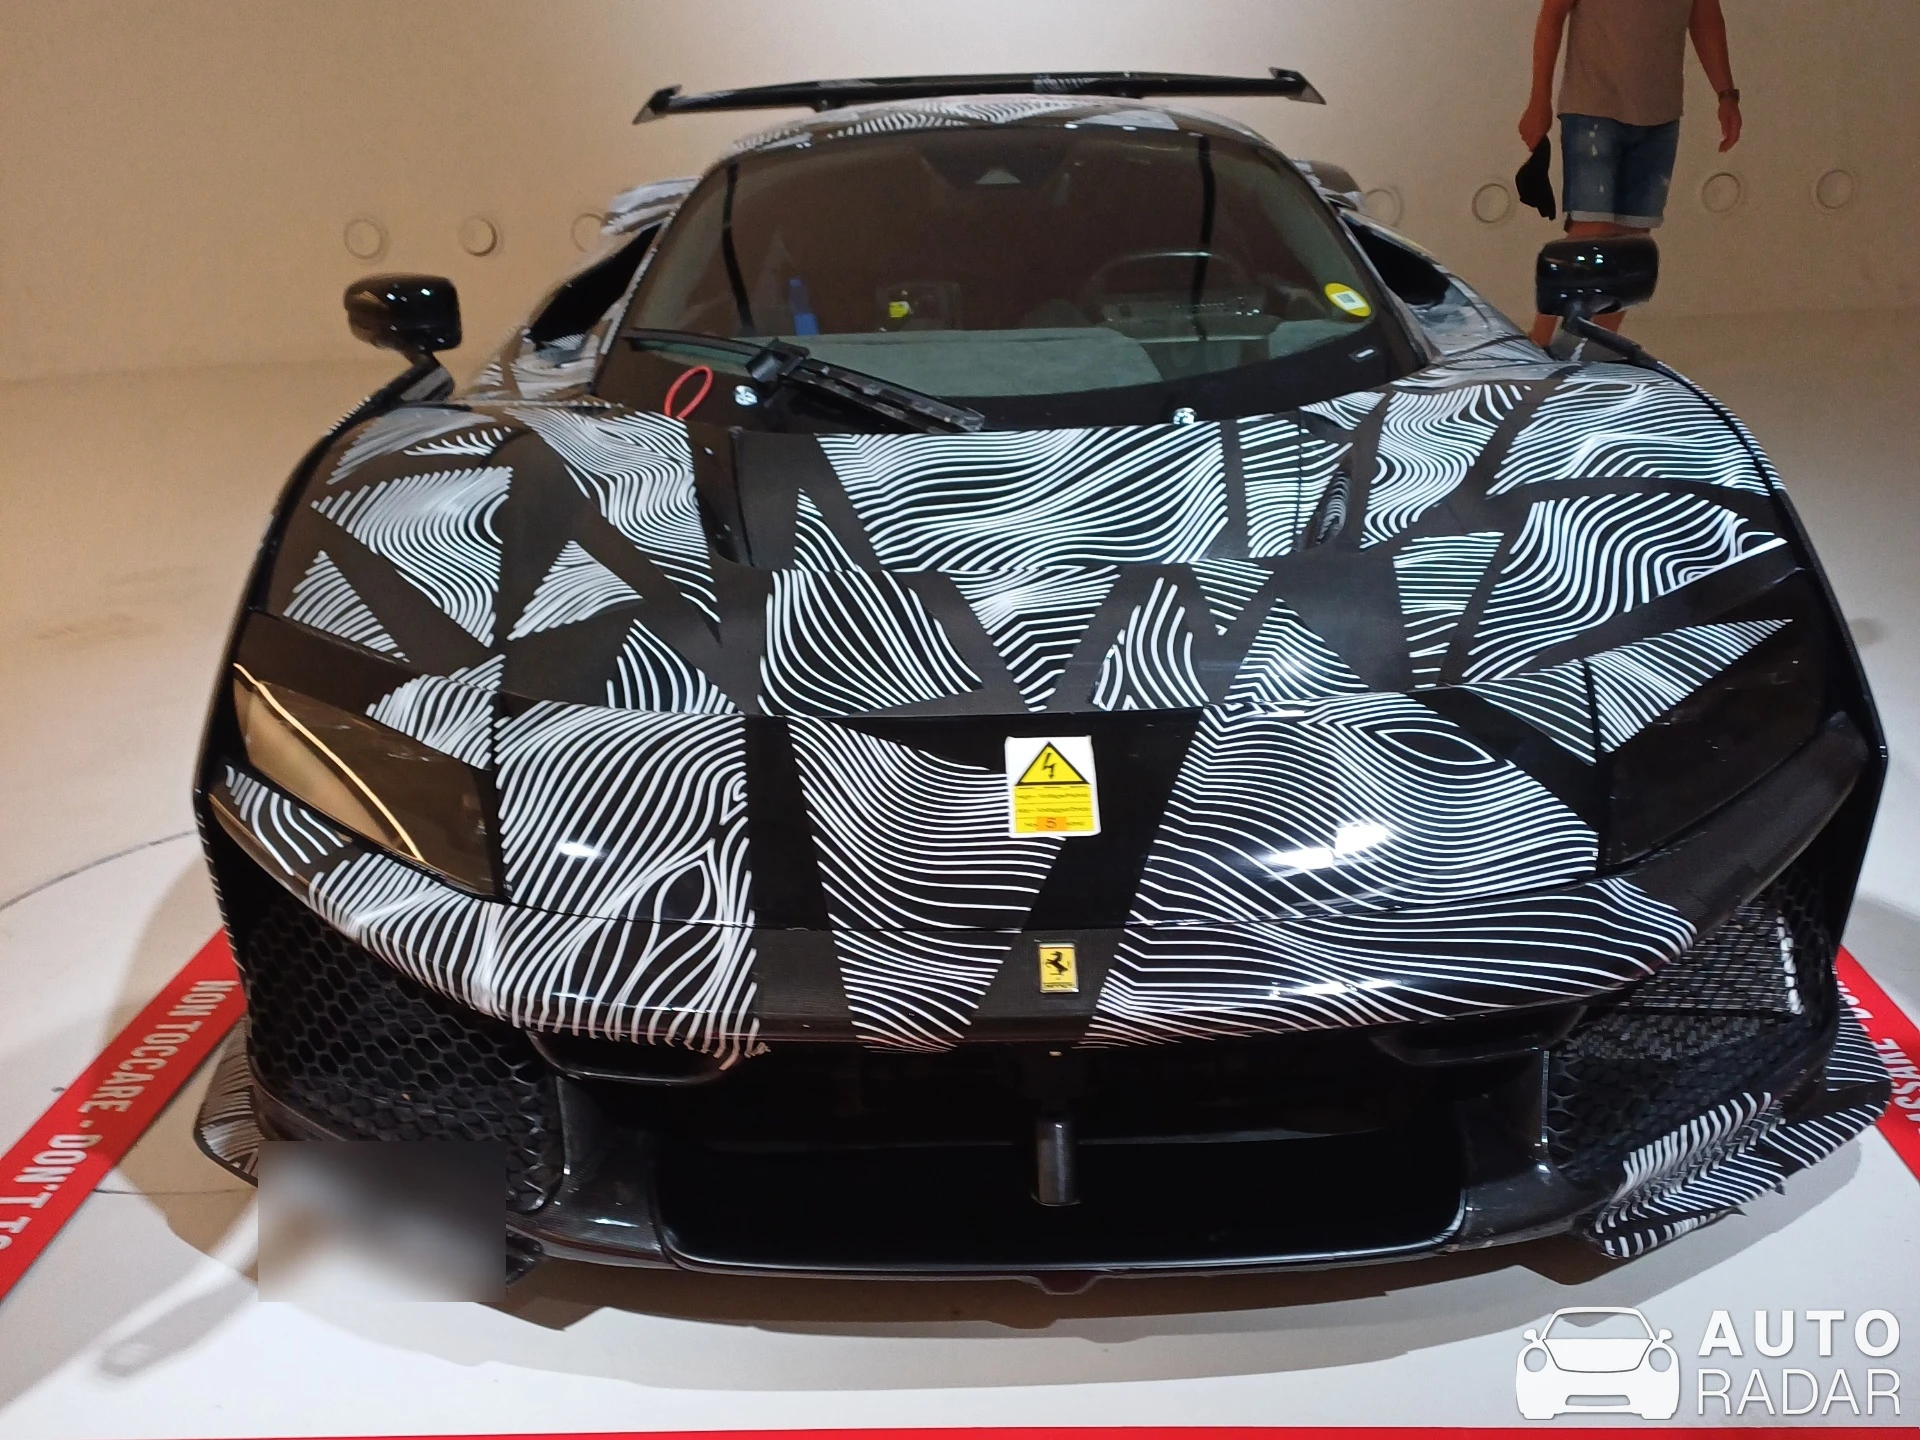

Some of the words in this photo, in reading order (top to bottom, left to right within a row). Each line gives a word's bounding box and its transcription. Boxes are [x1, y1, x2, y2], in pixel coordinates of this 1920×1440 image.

[166, 980, 240, 1016] NON
[77, 1020, 203, 1113] TOCCARE
[0, 1133, 104, 1209] DON'T
